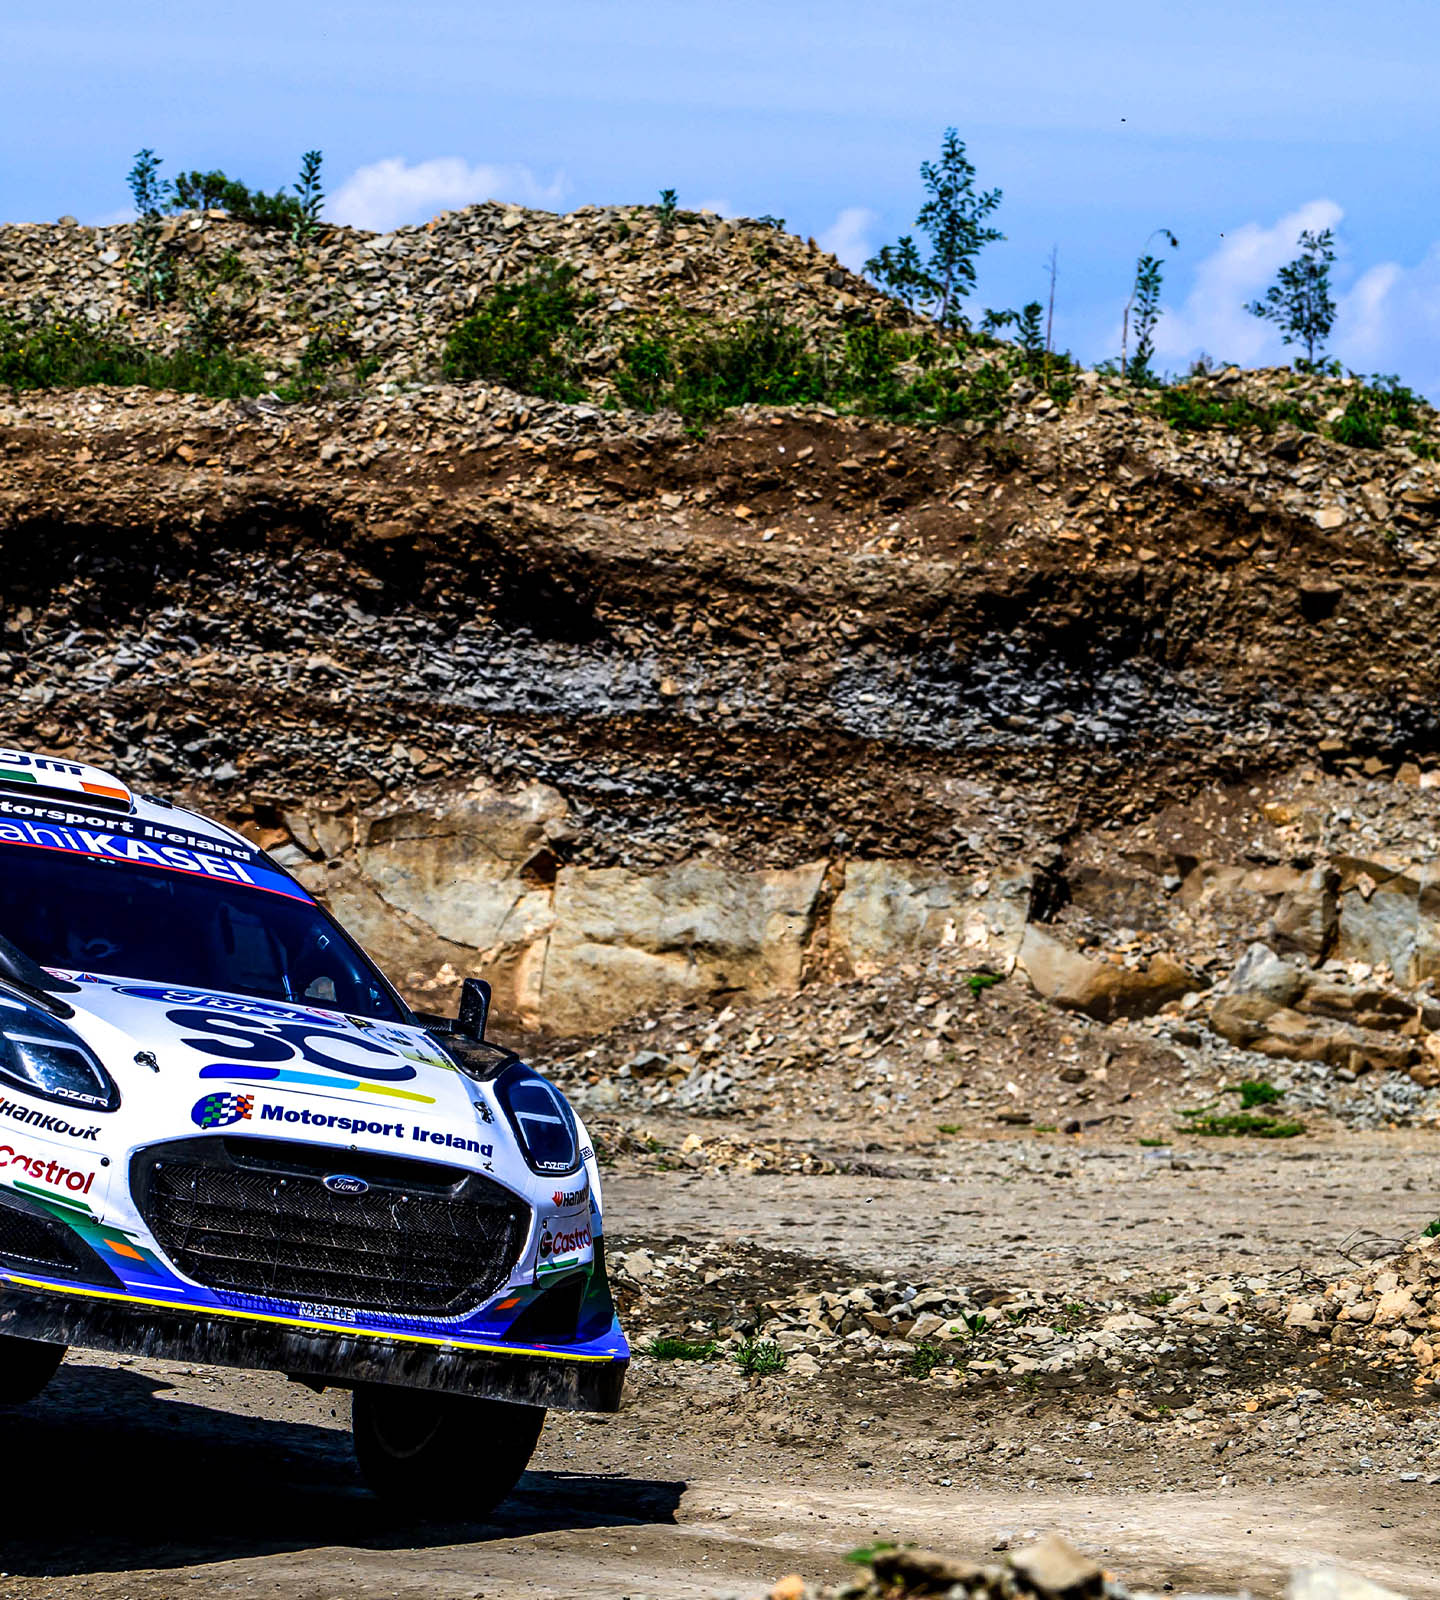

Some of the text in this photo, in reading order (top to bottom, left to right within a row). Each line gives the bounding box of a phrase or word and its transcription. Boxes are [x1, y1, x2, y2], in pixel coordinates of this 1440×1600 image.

[144, 826, 251, 861] Ireland
[162, 990, 306, 1021] Ford
[165, 1009, 417, 1081] SC
[260, 1103, 494, 1158] Motorsport Ireland
[334, 1177, 361, 1192] Ford
[552, 1221, 593, 1255] Castrol
